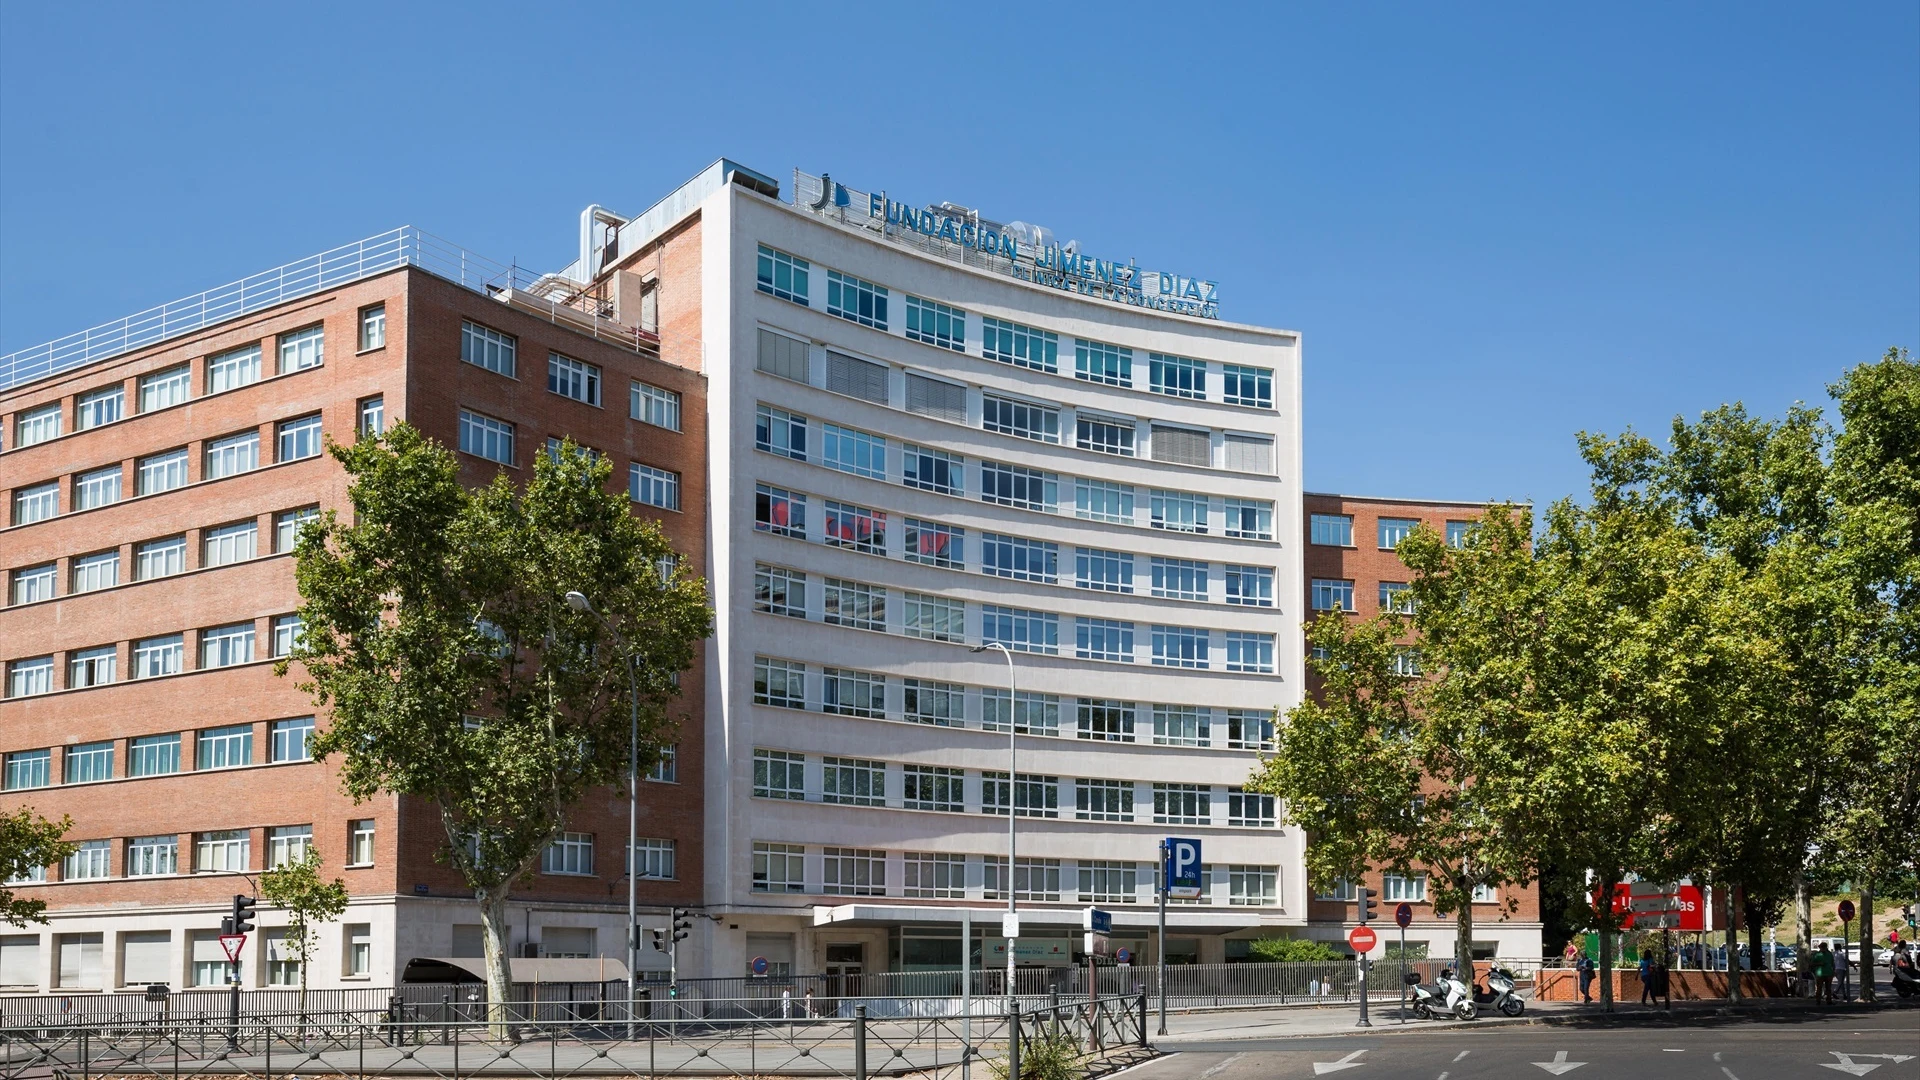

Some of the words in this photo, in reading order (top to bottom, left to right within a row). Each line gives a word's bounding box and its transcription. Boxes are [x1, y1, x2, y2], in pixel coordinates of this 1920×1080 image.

[868, 192, 1017, 260] FUNDACION
[1035, 245, 1142, 290] JIMENEZ
[1159, 271, 1219, 303] DIAZ
[1012, 265, 1071, 291] CLINICA
[1077, 280, 1095, 297] DE
[1102, 284, 1122, 303] LA
[1127, 292, 1219, 320] CONCEPCION
[1176, 842, 1196, 878] P
